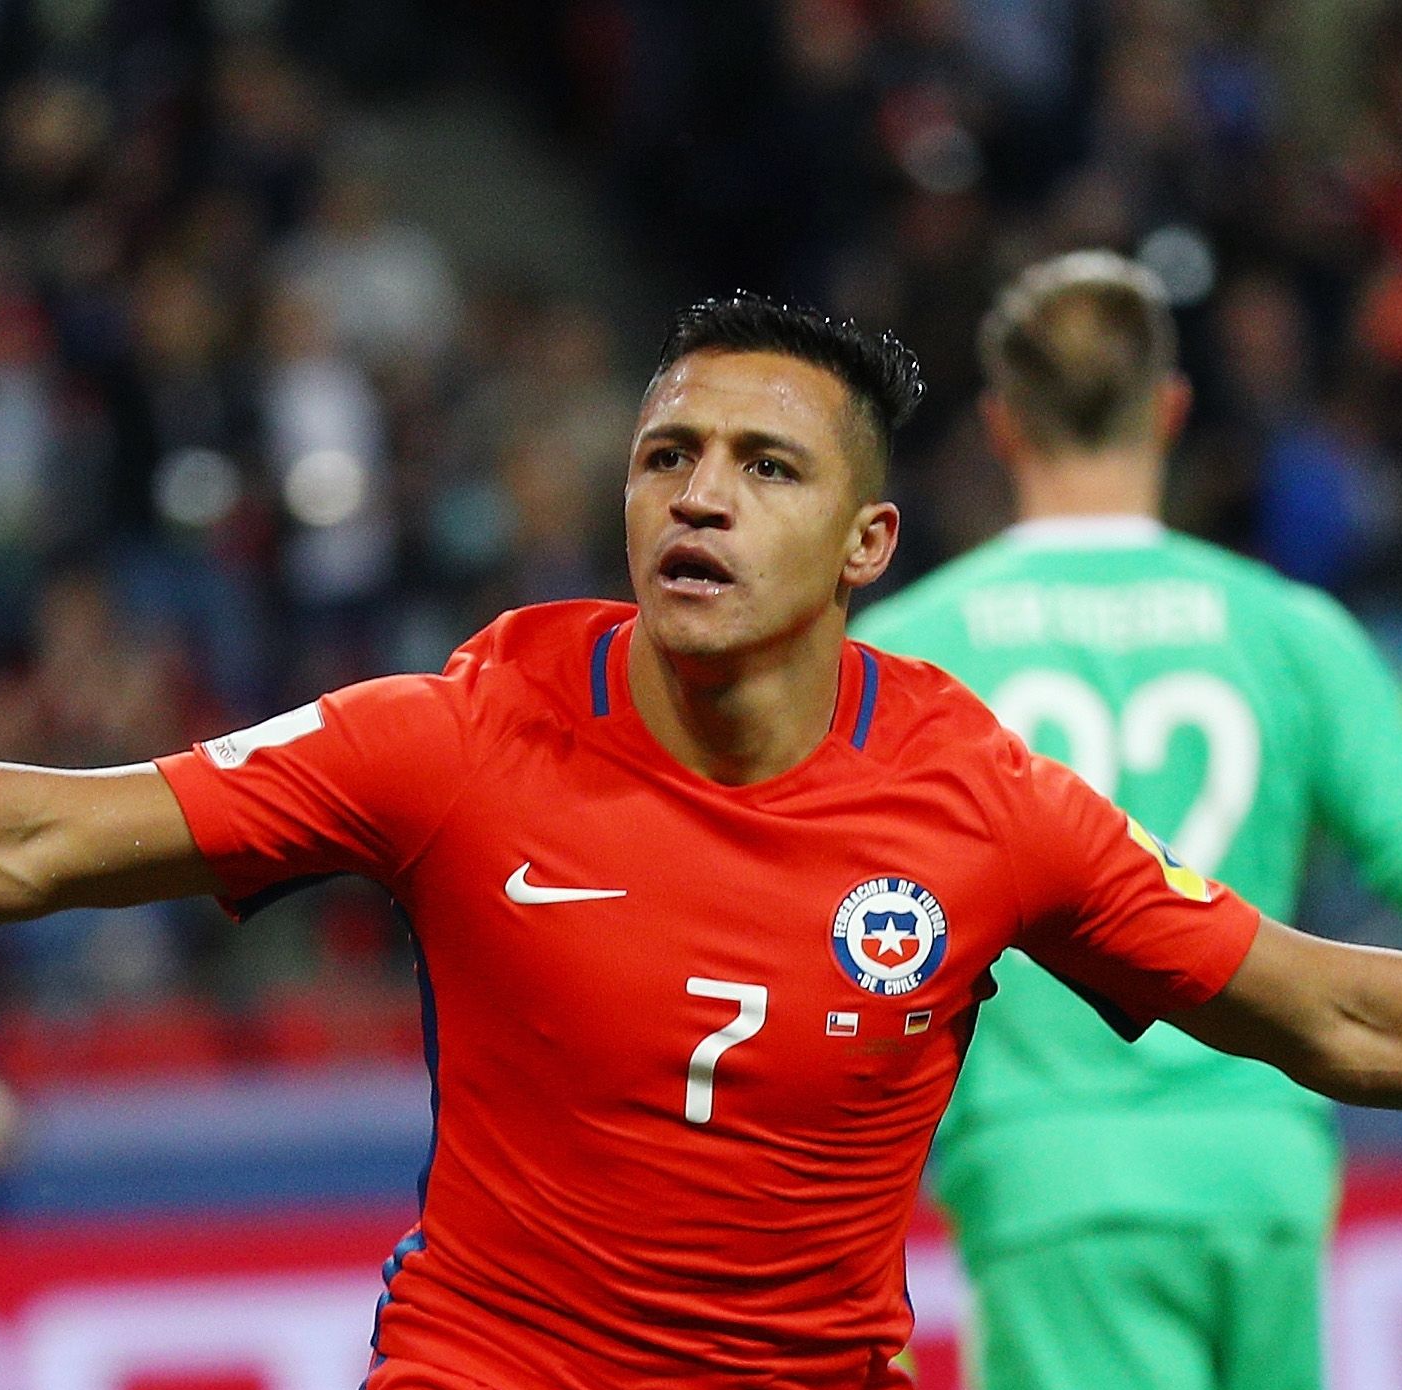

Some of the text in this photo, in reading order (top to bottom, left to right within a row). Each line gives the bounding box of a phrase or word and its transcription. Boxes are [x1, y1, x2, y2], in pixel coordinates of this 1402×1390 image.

[833, 877, 946, 939] FEDERACION DE FUTBOL
[684, 975, 769, 1124] 7
